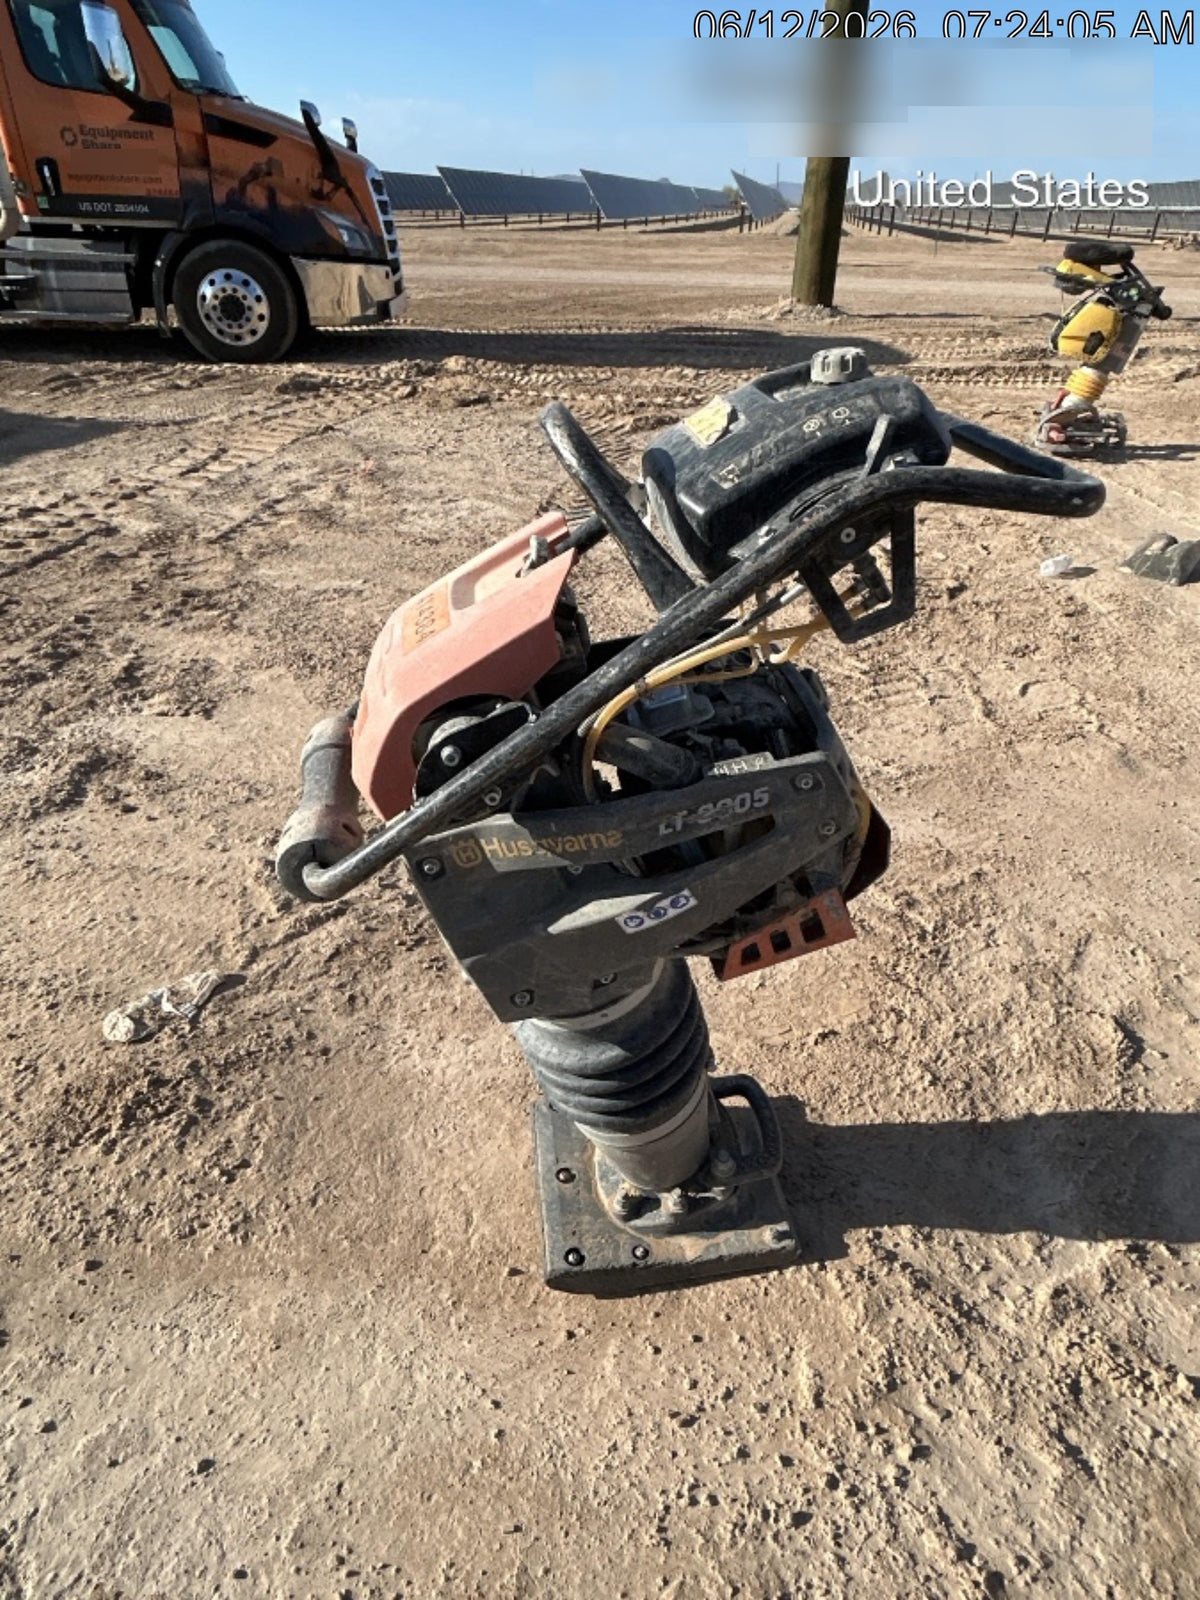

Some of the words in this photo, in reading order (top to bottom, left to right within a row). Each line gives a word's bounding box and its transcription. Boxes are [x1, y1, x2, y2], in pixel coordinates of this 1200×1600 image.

[78, 123, 154, 142] Equipment
[80, 138, 122, 150] Share
[78, 201, 93, 211] US
[94, 202, 113, 212] DOT
